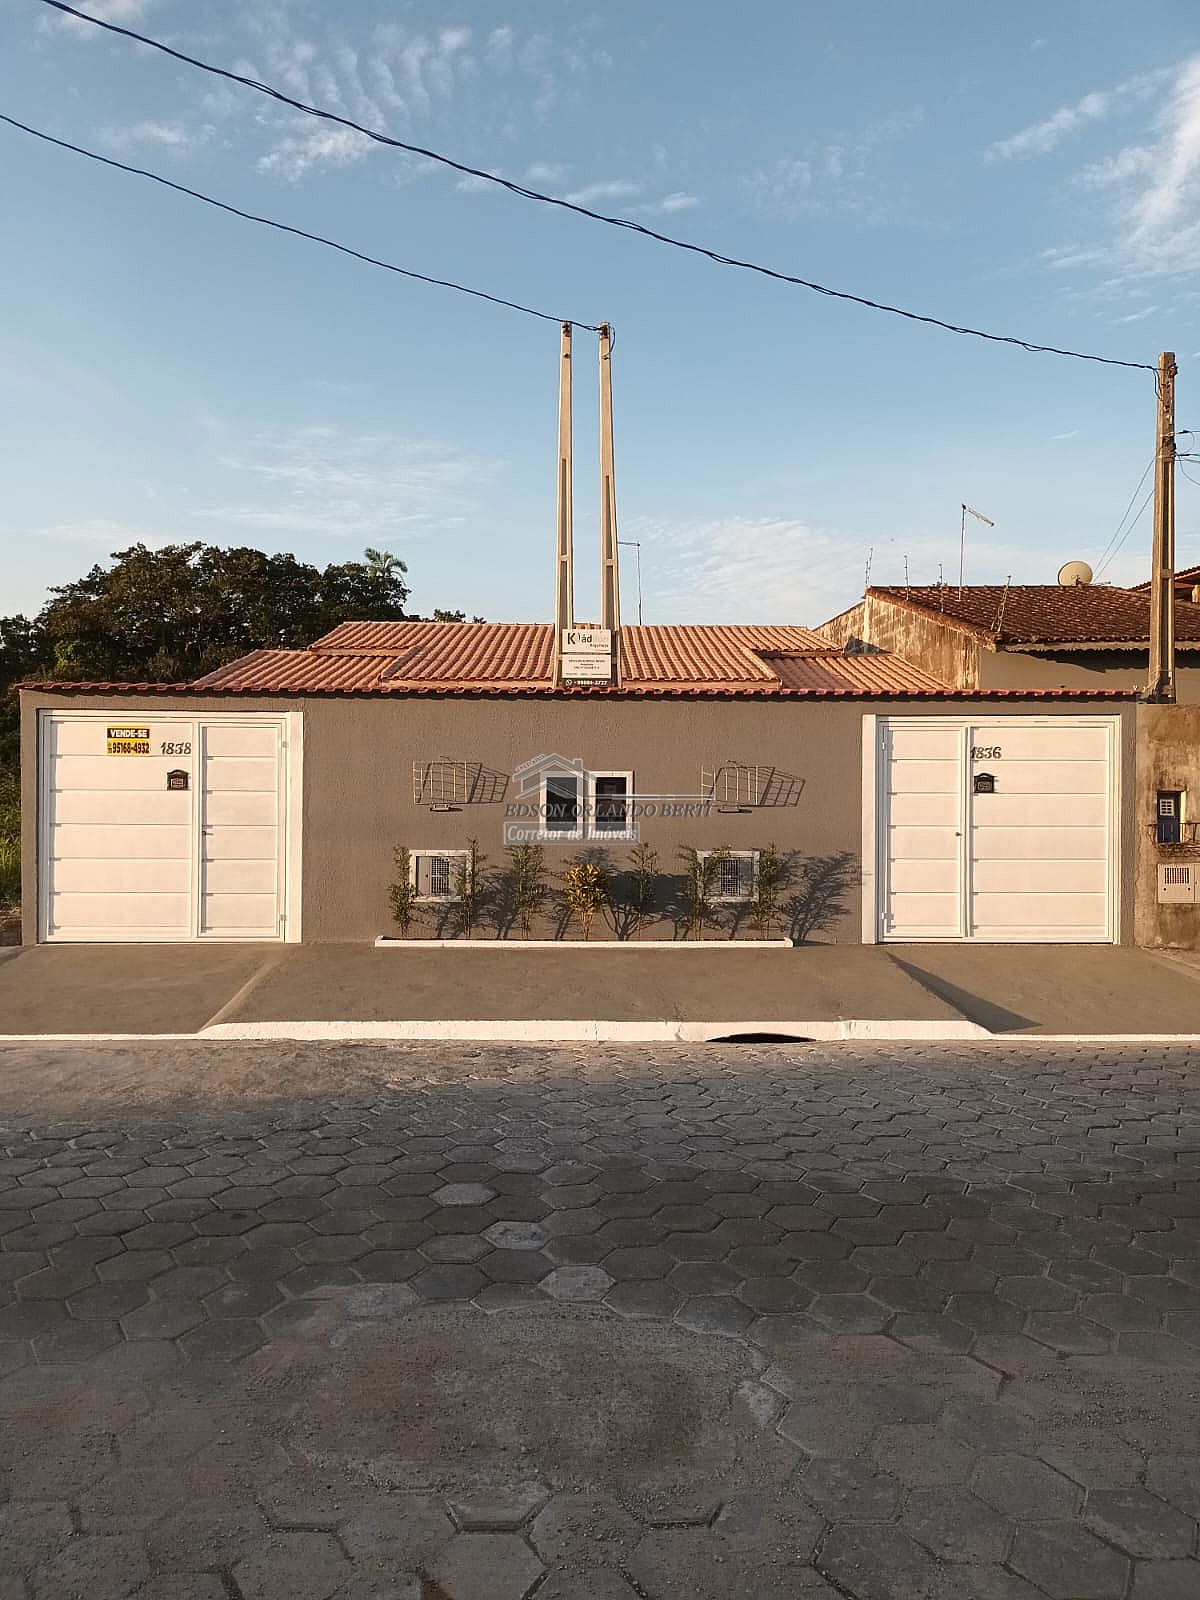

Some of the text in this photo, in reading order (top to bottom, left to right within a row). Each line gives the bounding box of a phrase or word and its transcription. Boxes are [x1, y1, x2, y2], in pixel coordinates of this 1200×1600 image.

[110, 729, 148, 738] VENDE-SE
[112, 742, 150, 754] 95168-4932
[160, 742, 192, 755] 1838
[970, 746, 1002, 759] 1836
